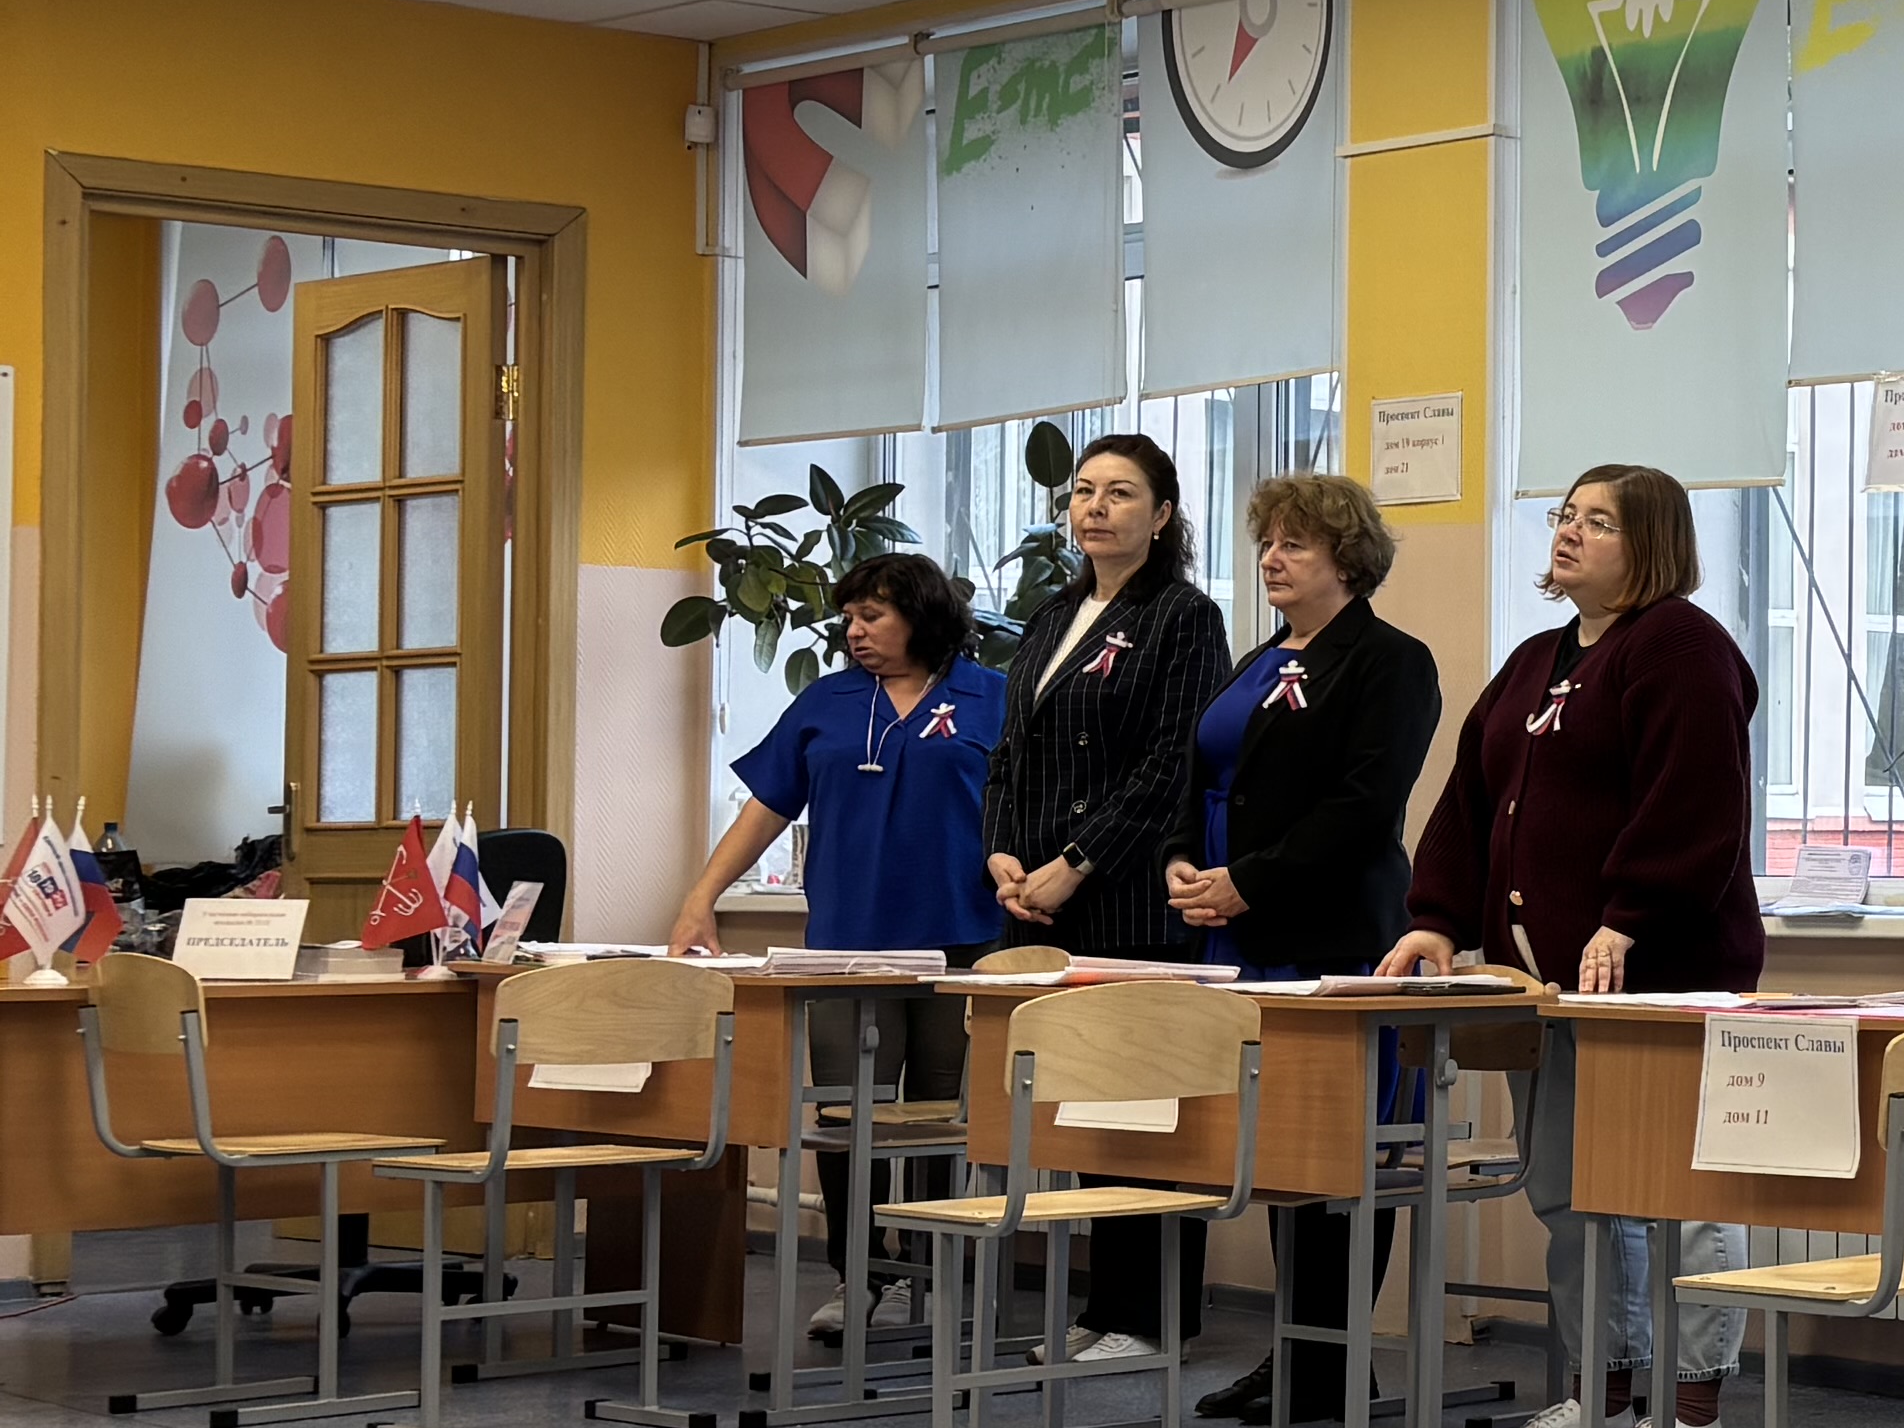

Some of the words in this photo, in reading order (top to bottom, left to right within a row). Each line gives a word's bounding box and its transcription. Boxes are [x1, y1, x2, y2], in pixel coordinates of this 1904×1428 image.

[1721, 1030, 1790, 1053] Проспект
[1794, 1034, 1845, 1053] Славы
[1726, 1075, 1753, 1087] дом
[1757, 1072, 1765, 1088] 9
[1723, 1111, 1750, 1124] дом
[1755, 1109, 1769, 1124] 11
